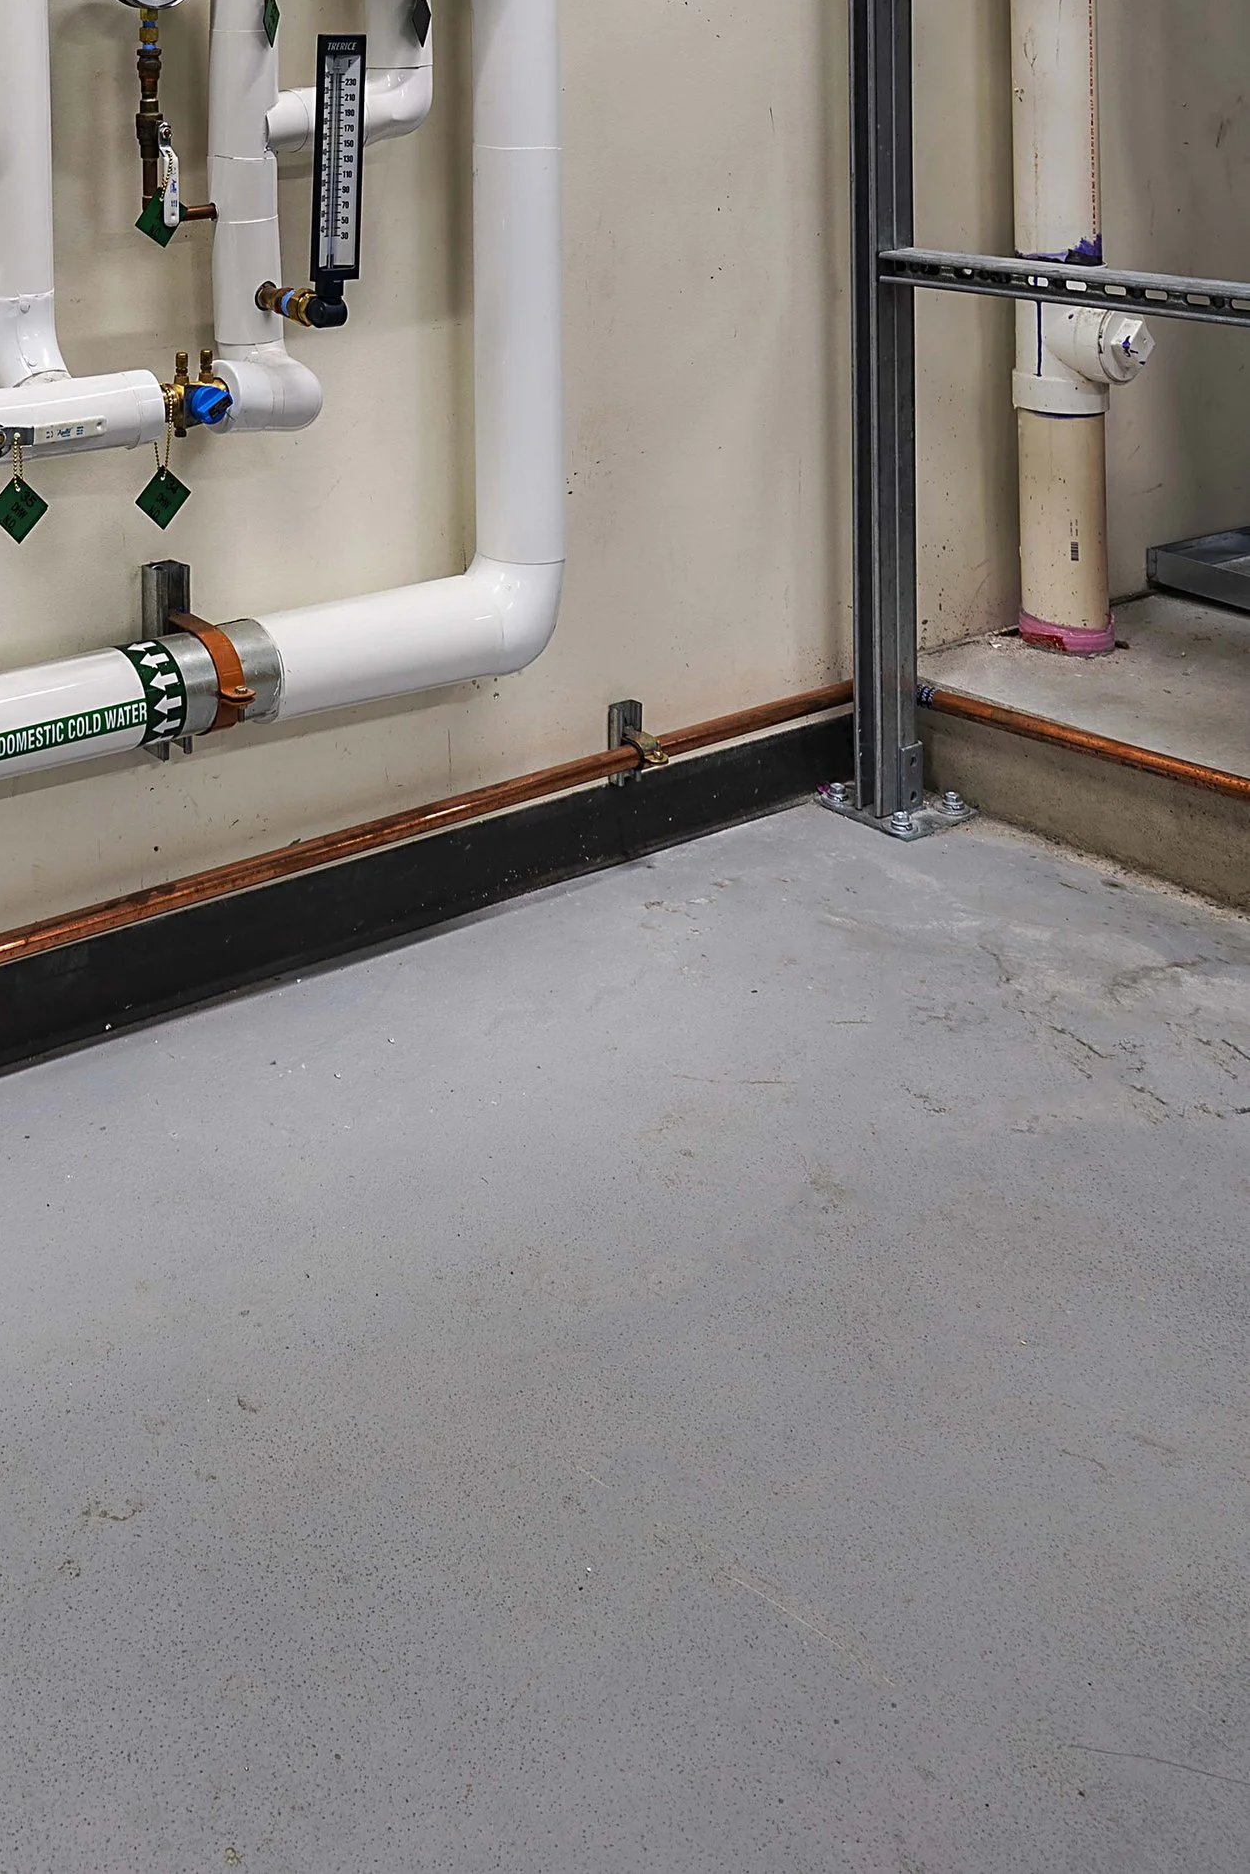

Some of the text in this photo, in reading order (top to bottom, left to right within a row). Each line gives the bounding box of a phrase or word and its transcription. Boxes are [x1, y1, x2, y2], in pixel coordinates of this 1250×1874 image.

[327, 42, 357, 51] TRERICE
[345, 78, 357, 86] 230
[344, 93, 356, 102] 210
[344, 124, 354, 132] 170
[343, 139, 354, 148] 150
[343, 155, 354, 163] 130
[342, 170, 353, 178] 110
[68, 713, 102, 740] COLD
[105, 701, 148, 730] WATER
